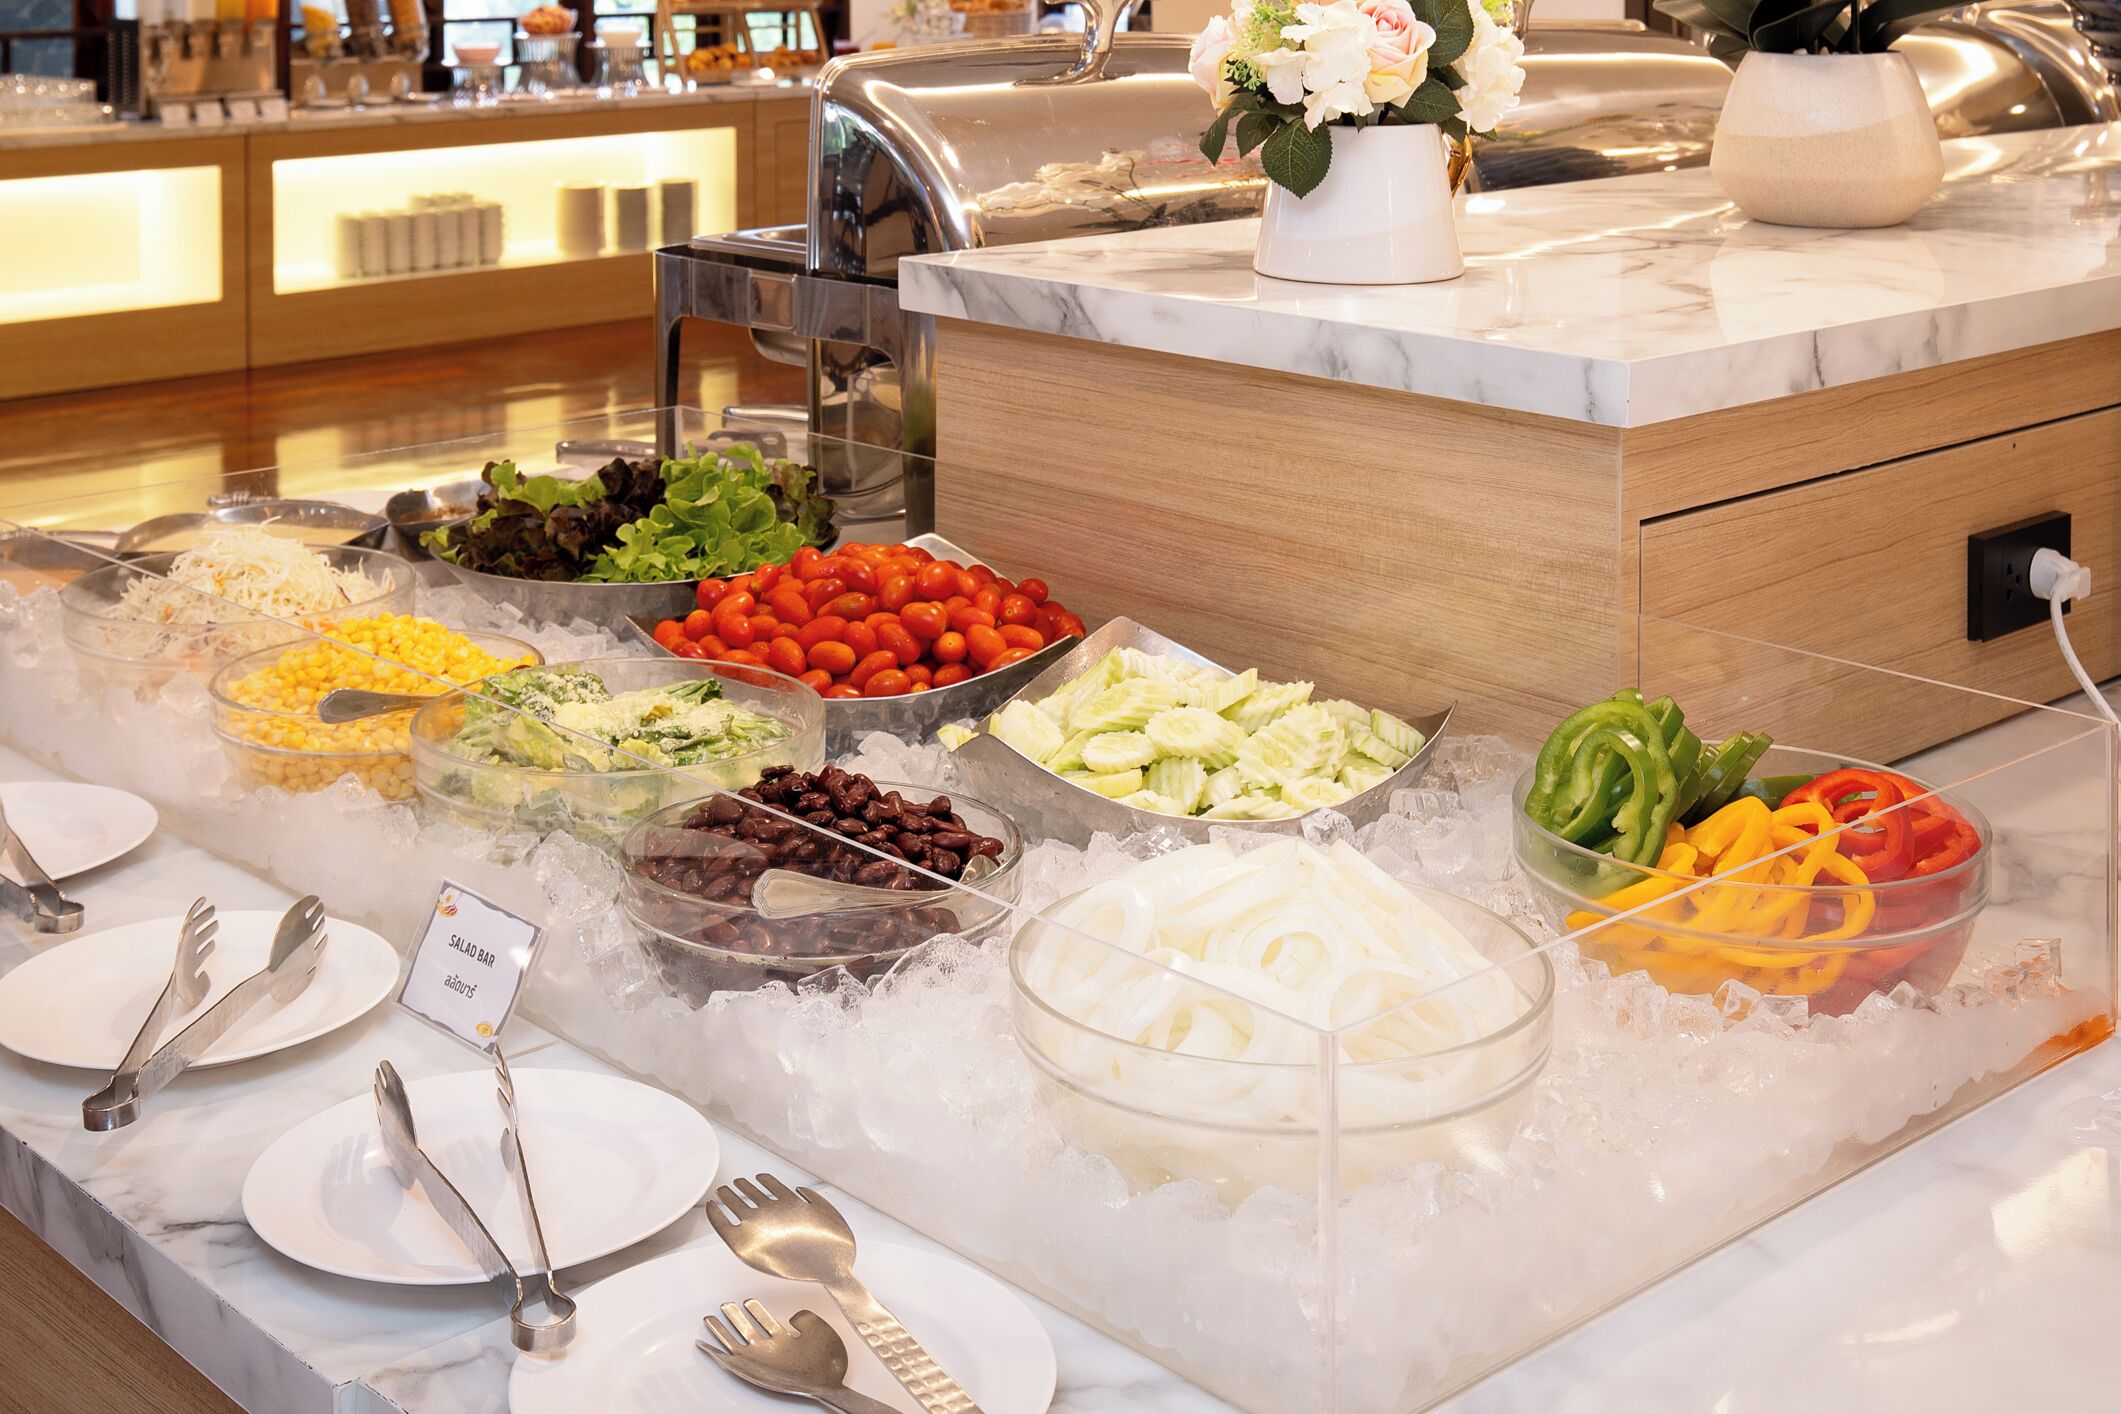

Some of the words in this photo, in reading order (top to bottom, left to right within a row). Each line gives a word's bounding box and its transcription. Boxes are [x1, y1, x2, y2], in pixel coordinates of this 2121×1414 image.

[448, 934, 477, 958] SALAD
[477, 948, 495, 968] BAR
[444, 974, 477, 999] สลัดบาร์
